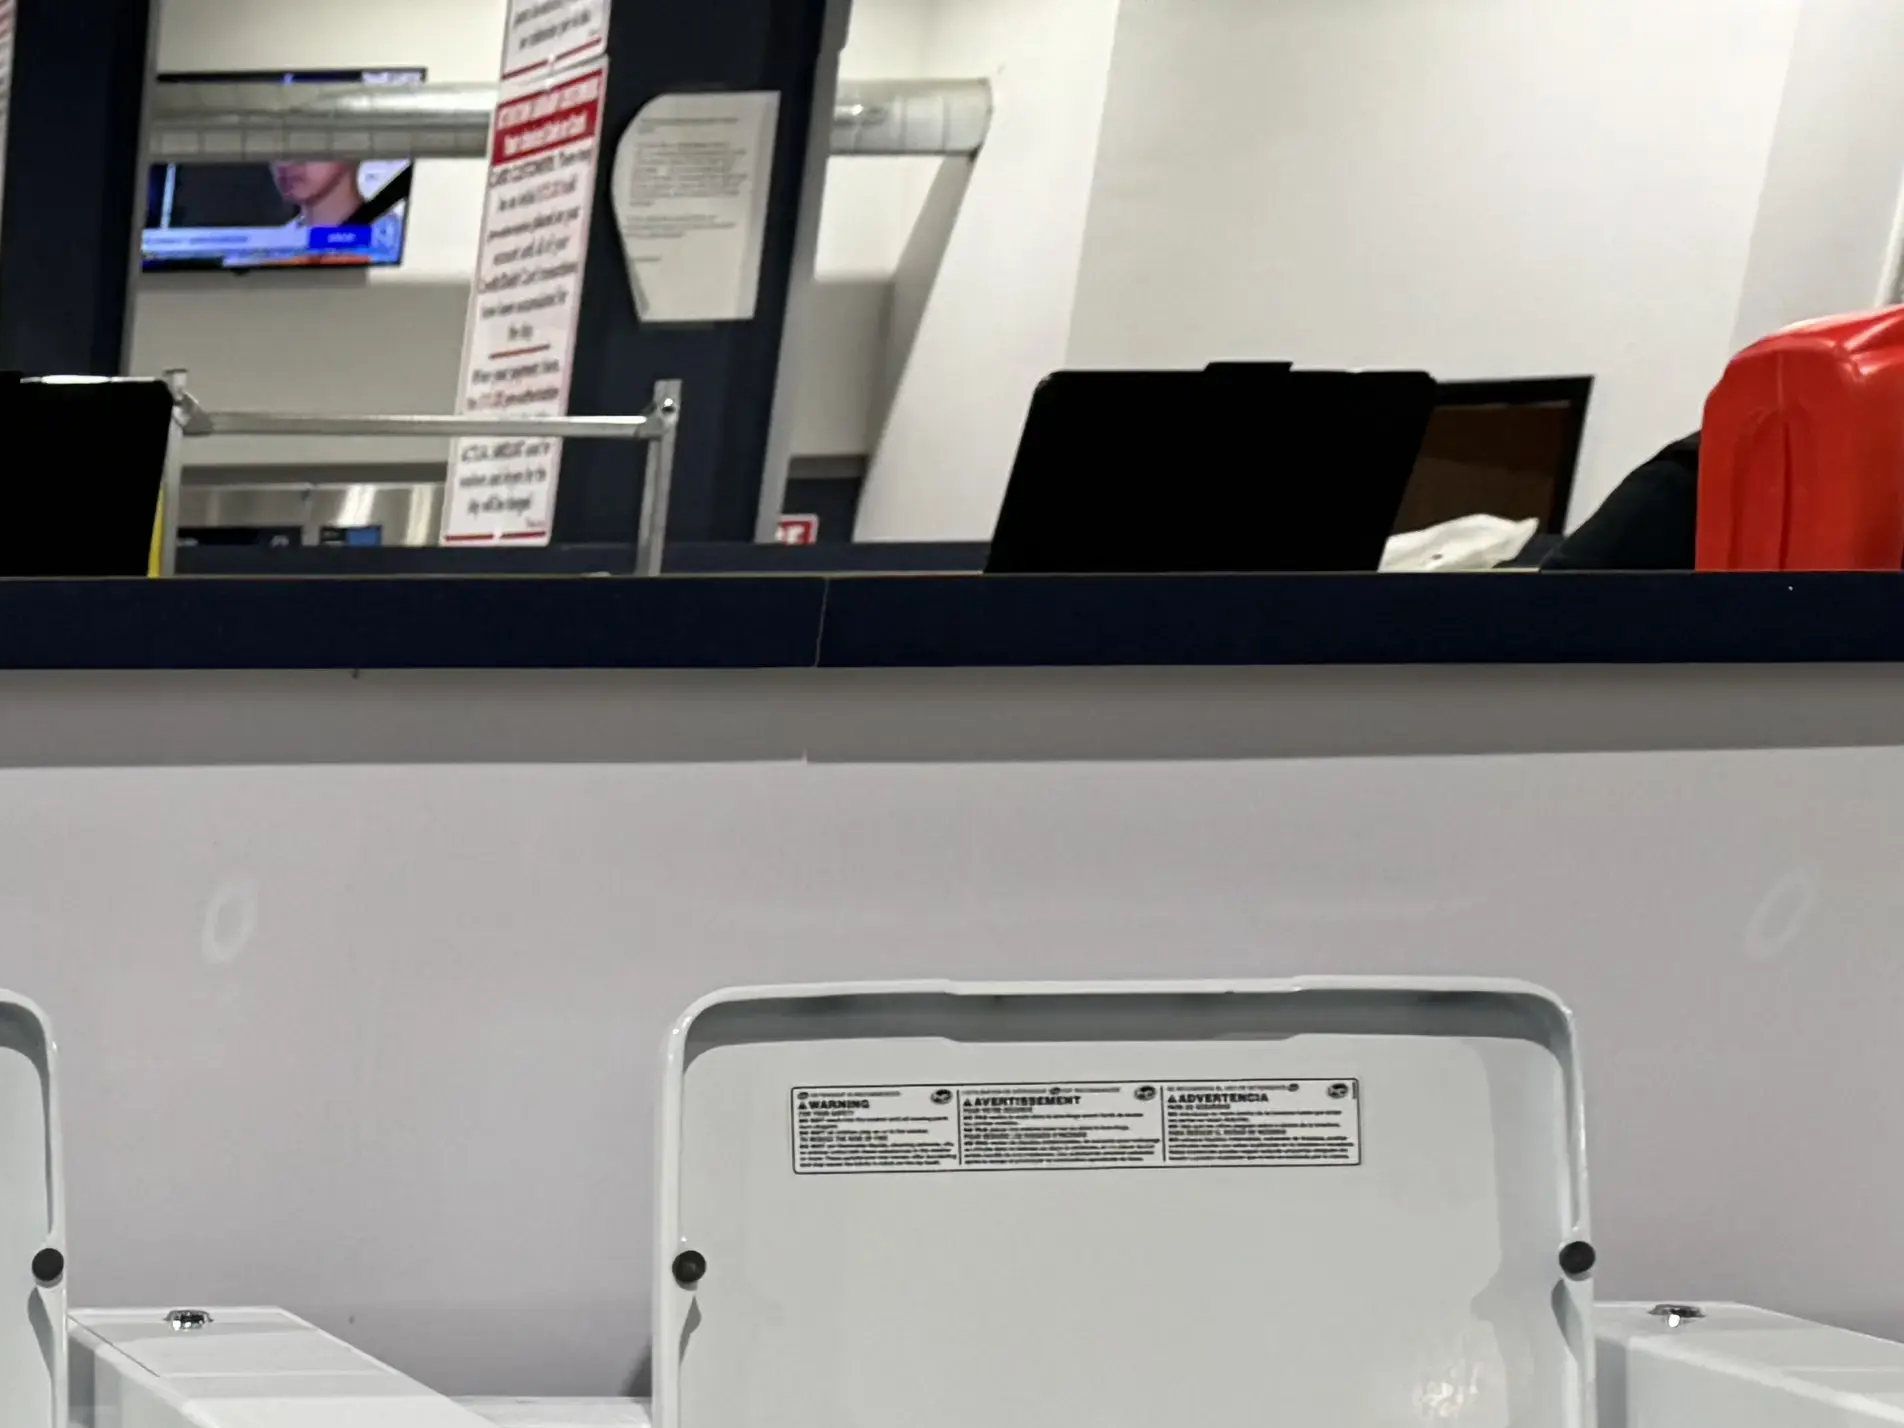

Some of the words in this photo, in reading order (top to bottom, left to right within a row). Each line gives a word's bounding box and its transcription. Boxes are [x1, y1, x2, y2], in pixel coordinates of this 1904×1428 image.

[974, 1095, 1081, 1106] AVERTISSEMENT
[1180, 1093, 1269, 1103] ADVERTENCIA
[809, 1099, 870, 1109] WARNING
